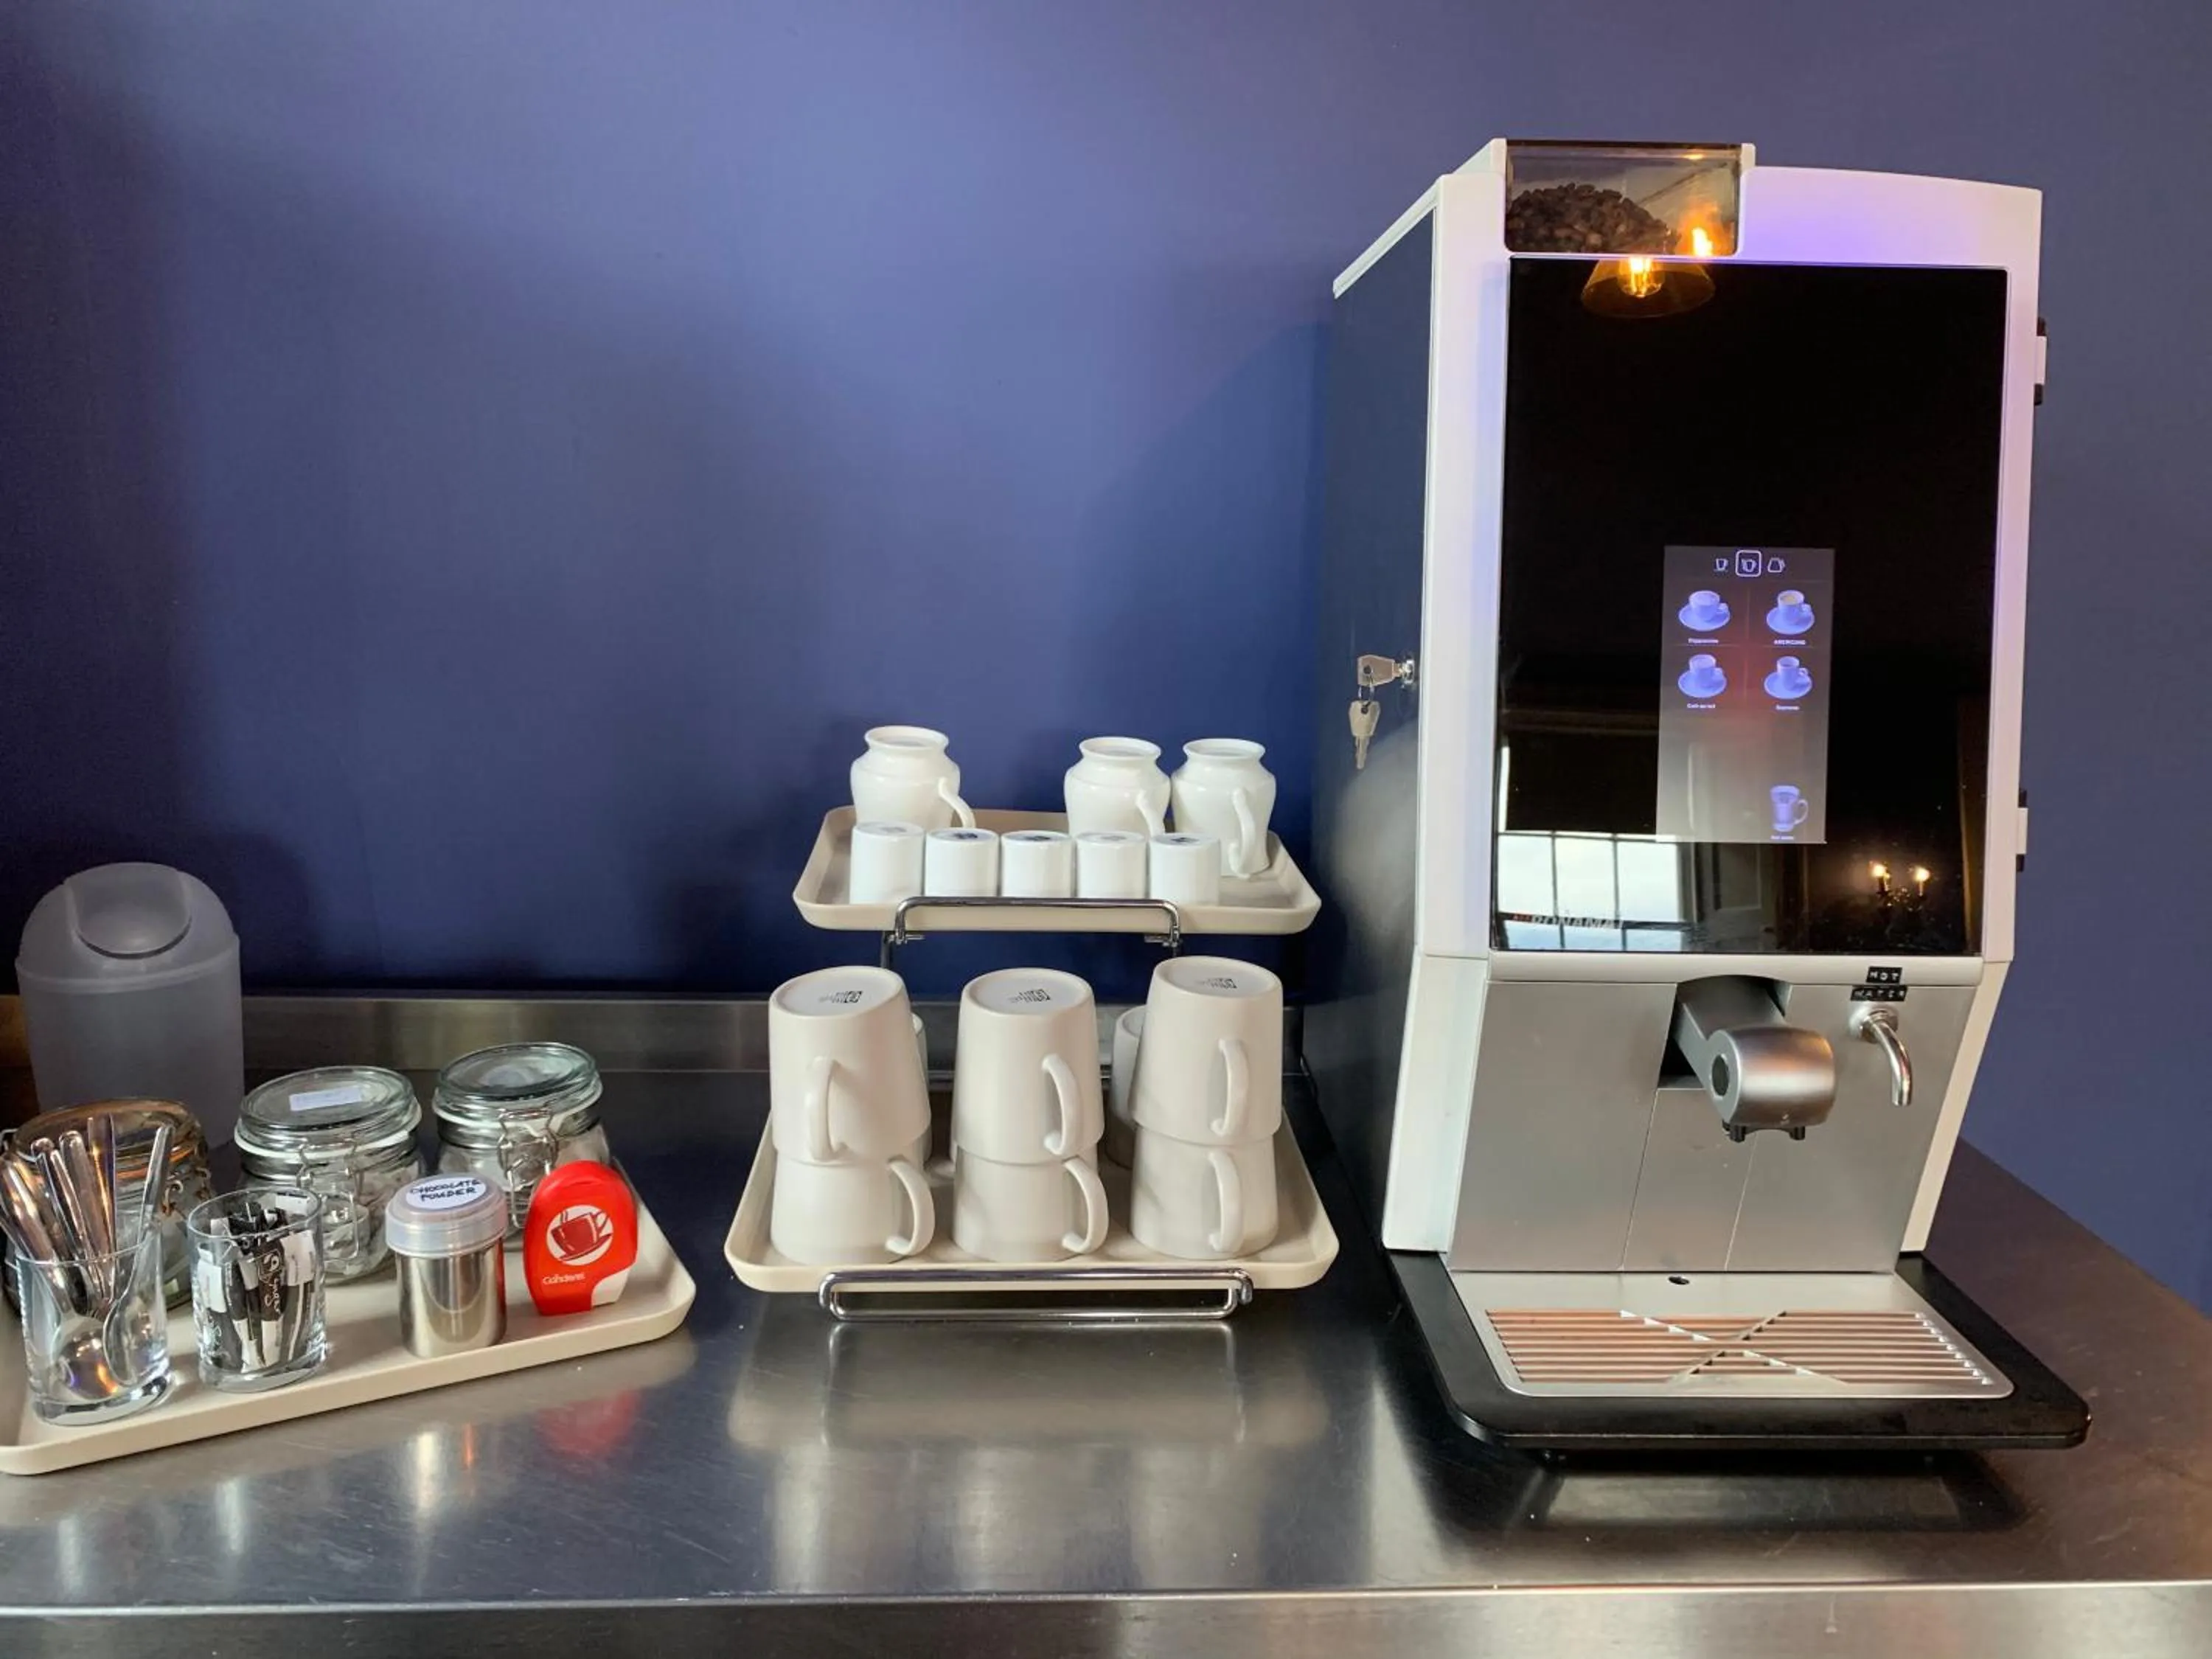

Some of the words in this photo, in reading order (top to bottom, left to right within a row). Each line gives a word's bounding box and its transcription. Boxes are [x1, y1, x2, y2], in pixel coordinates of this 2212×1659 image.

[1869, 970, 1899, 981] HOT
[410, 1180, 481, 1194] CHOCOLATE
[421, 1186, 476, 1202] POWDER
